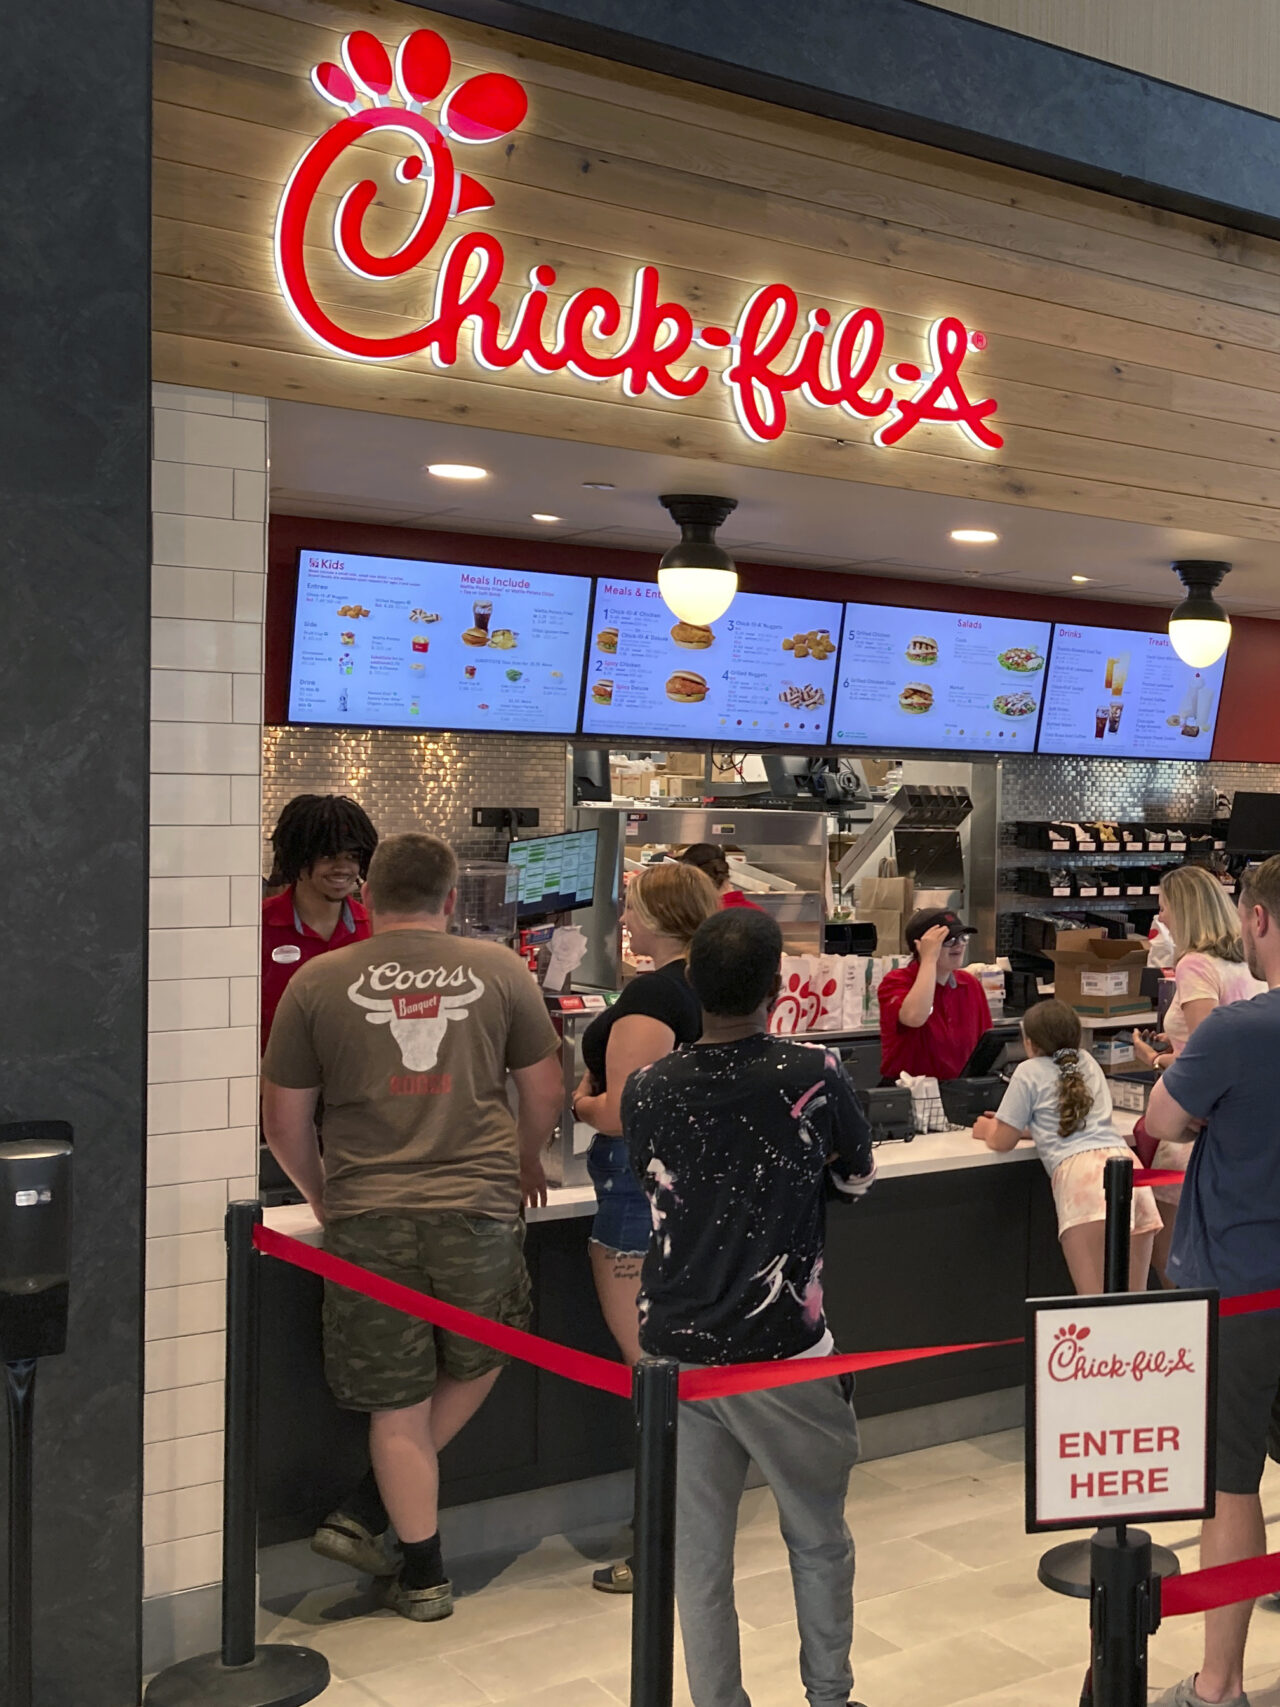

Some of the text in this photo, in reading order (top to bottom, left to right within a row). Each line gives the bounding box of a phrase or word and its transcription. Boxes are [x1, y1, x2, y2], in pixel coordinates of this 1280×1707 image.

[277, 100, 1004, 450] Chick-fil-A
[320, 560, 345, 570] Kids
[461, 573, 531, 589] Meals Include
[604, 584, 632, 596] Meals
[635, 588, 641, 597] &
[603, 608, 609, 620] 1
[727, 619, 734, 632] 3
[957, 618, 982, 630] Salads
[848, 630, 855, 641] 5
[1059, 628, 1082, 639] Drinks
[1148, 637, 1169, 647] Treats
[595, 660, 603, 672] 2
[721, 670, 729, 681] 4
[843, 678, 850, 688] 6
[368, 962, 467, 991] Coors
[398, 995, 437, 1018] Banquet
[1048, 1336, 1196, 1382] Chick-fil-A
[1059, 1426, 1181, 1459] ENTER
[1070, 1467, 1169, 1500] HERE
